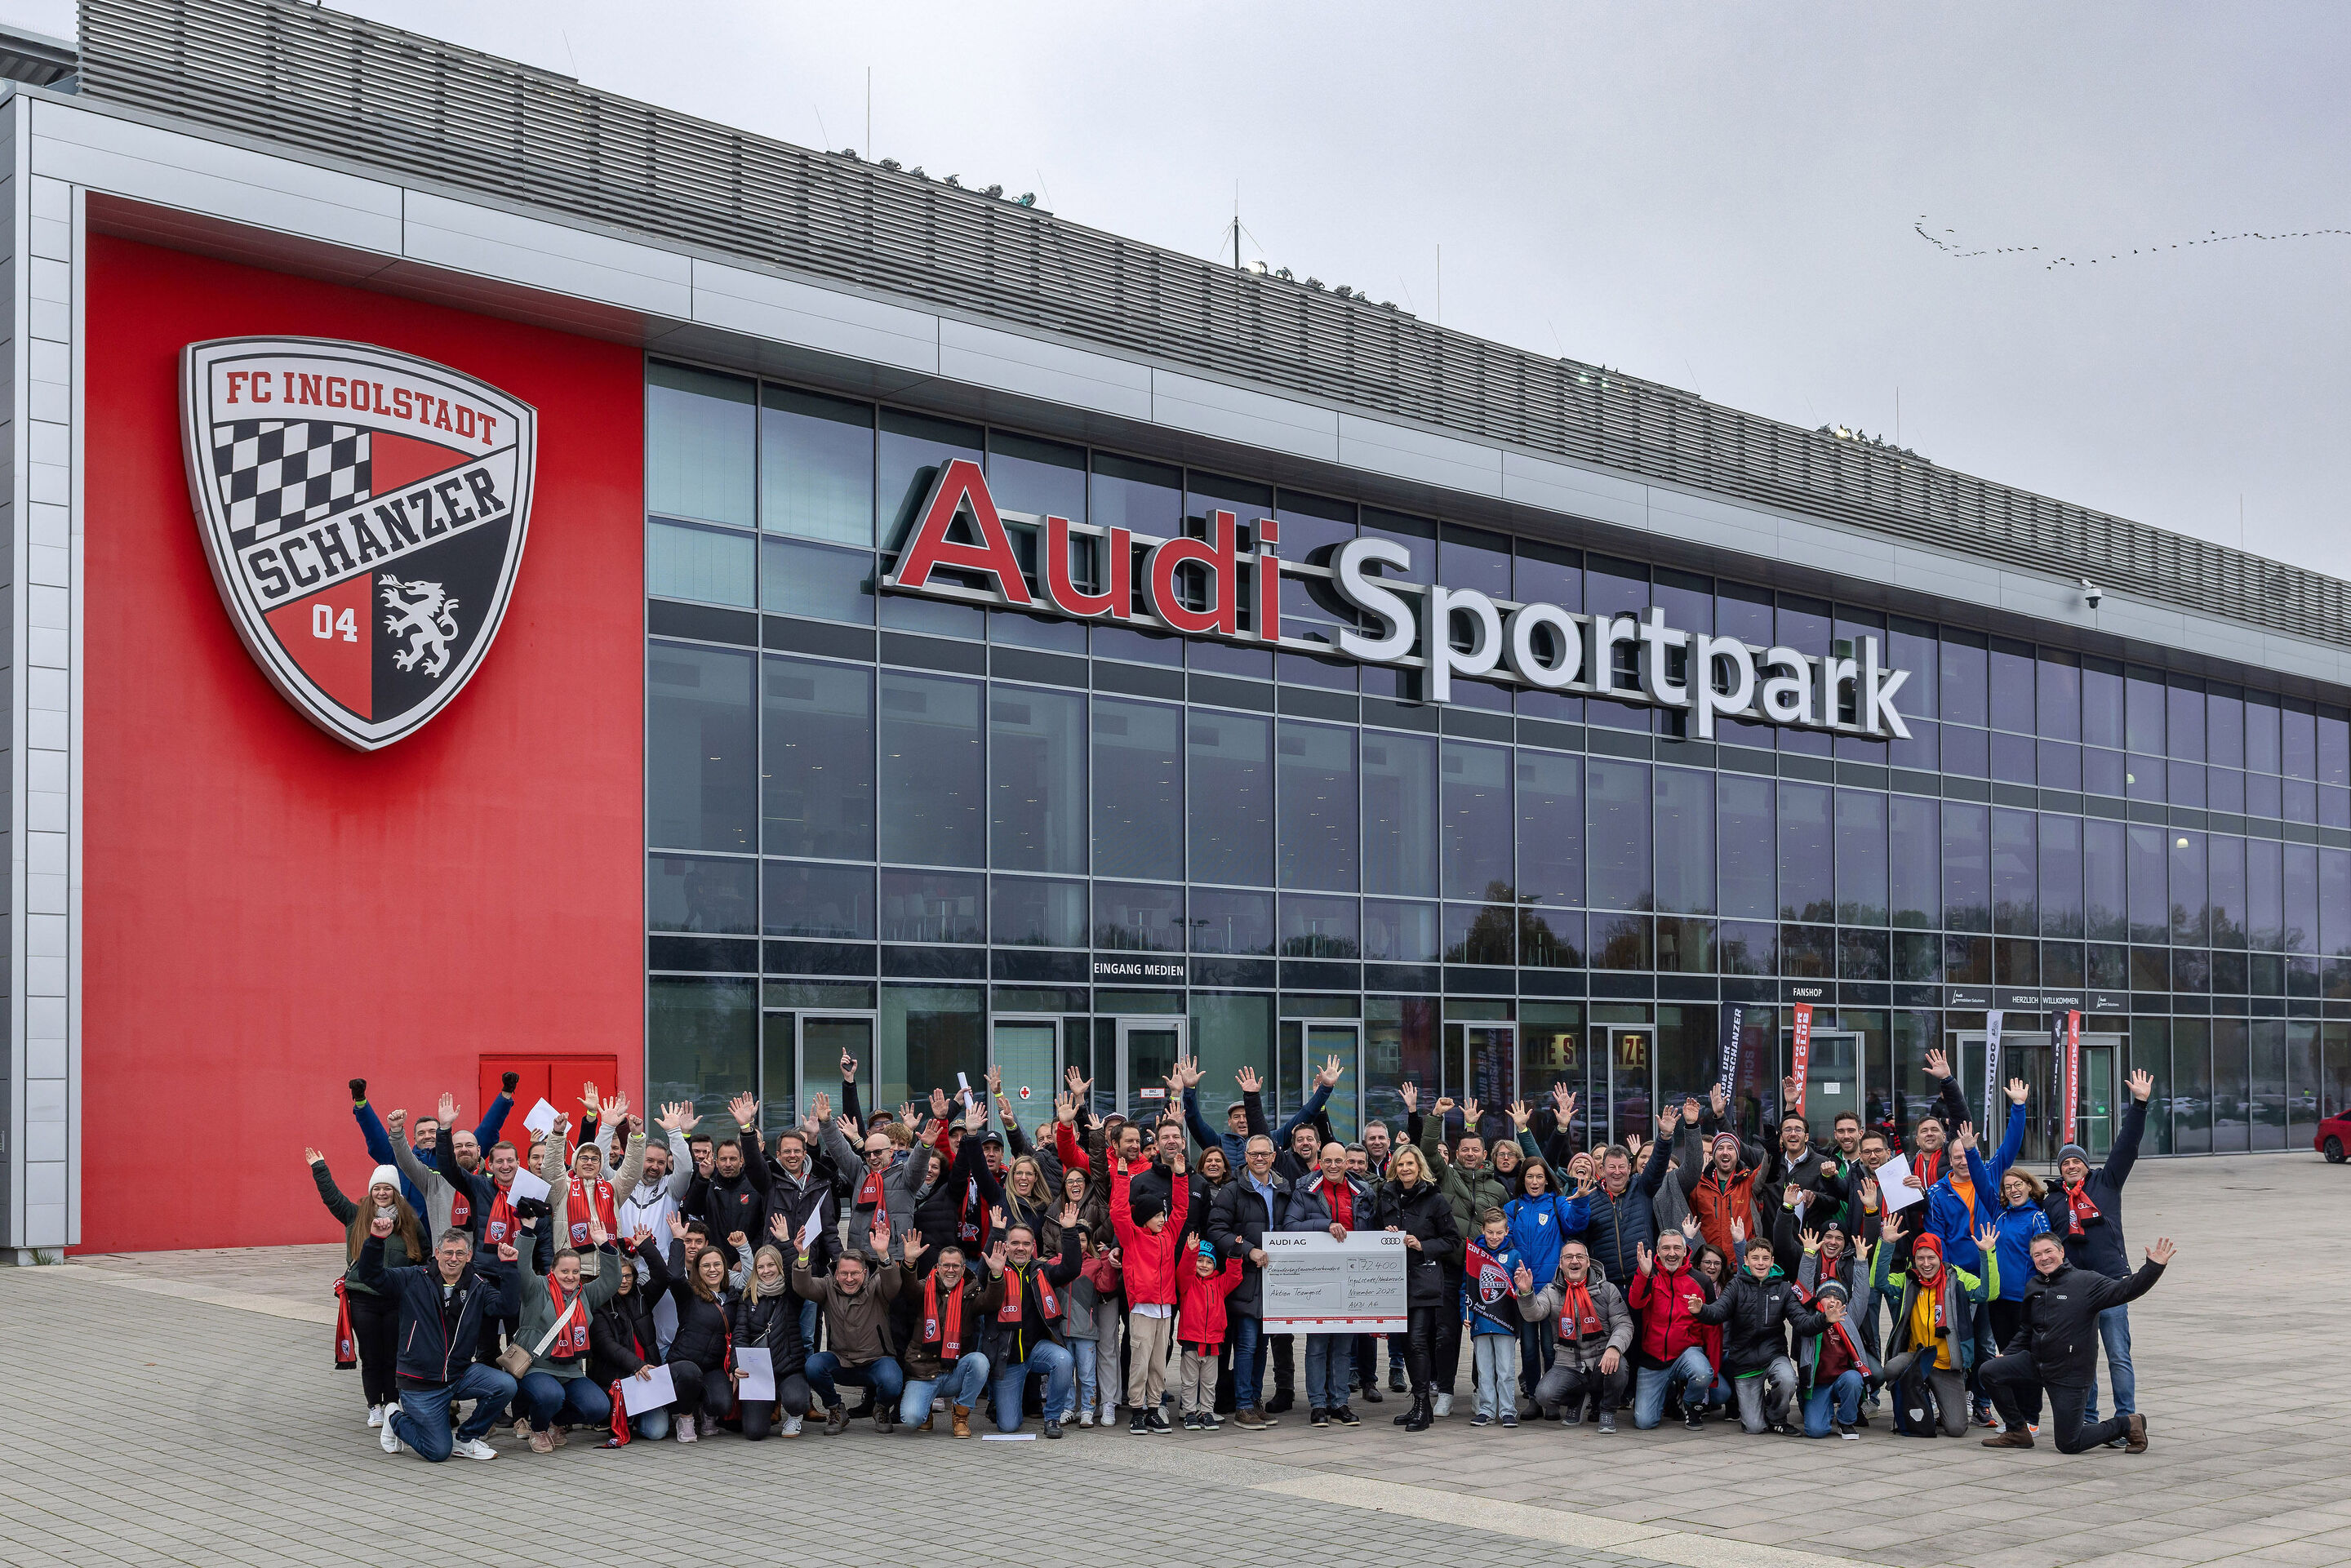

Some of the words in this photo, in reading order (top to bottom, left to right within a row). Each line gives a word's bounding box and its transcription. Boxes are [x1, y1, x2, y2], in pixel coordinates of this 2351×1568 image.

[226, 371, 272, 404] FC
[283, 371, 497, 446] INGOLSTADT
[247, 467, 506, 600] SCHANZER
[890, 459, 1281, 642] Audi
[1335, 535, 1913, 740] Sportpark
[312, 603, 358, 642] 04
[1094, 963, 1141, 975] EINGANG
[1144, 965, 1184, 976] MEDIEN
[1793, 988, 1823, 997] FANSHOP
[2012, 996, 2039, 1004] HERZLICH
[2042, 997, 2079, 1005] WILLKOMMEN
[1799, 1012, 1809, 1057] CLUB
[1488, 1028, 1501, 1105] JUNGSCHANZ
[572, 1184, 580, 1197] FC
[1468, 1243, 1480, 1255] EIN
[1293, 1288, 1322, 1300] Teamgeist
[1474, 1302, 1487, 1311] Audi
